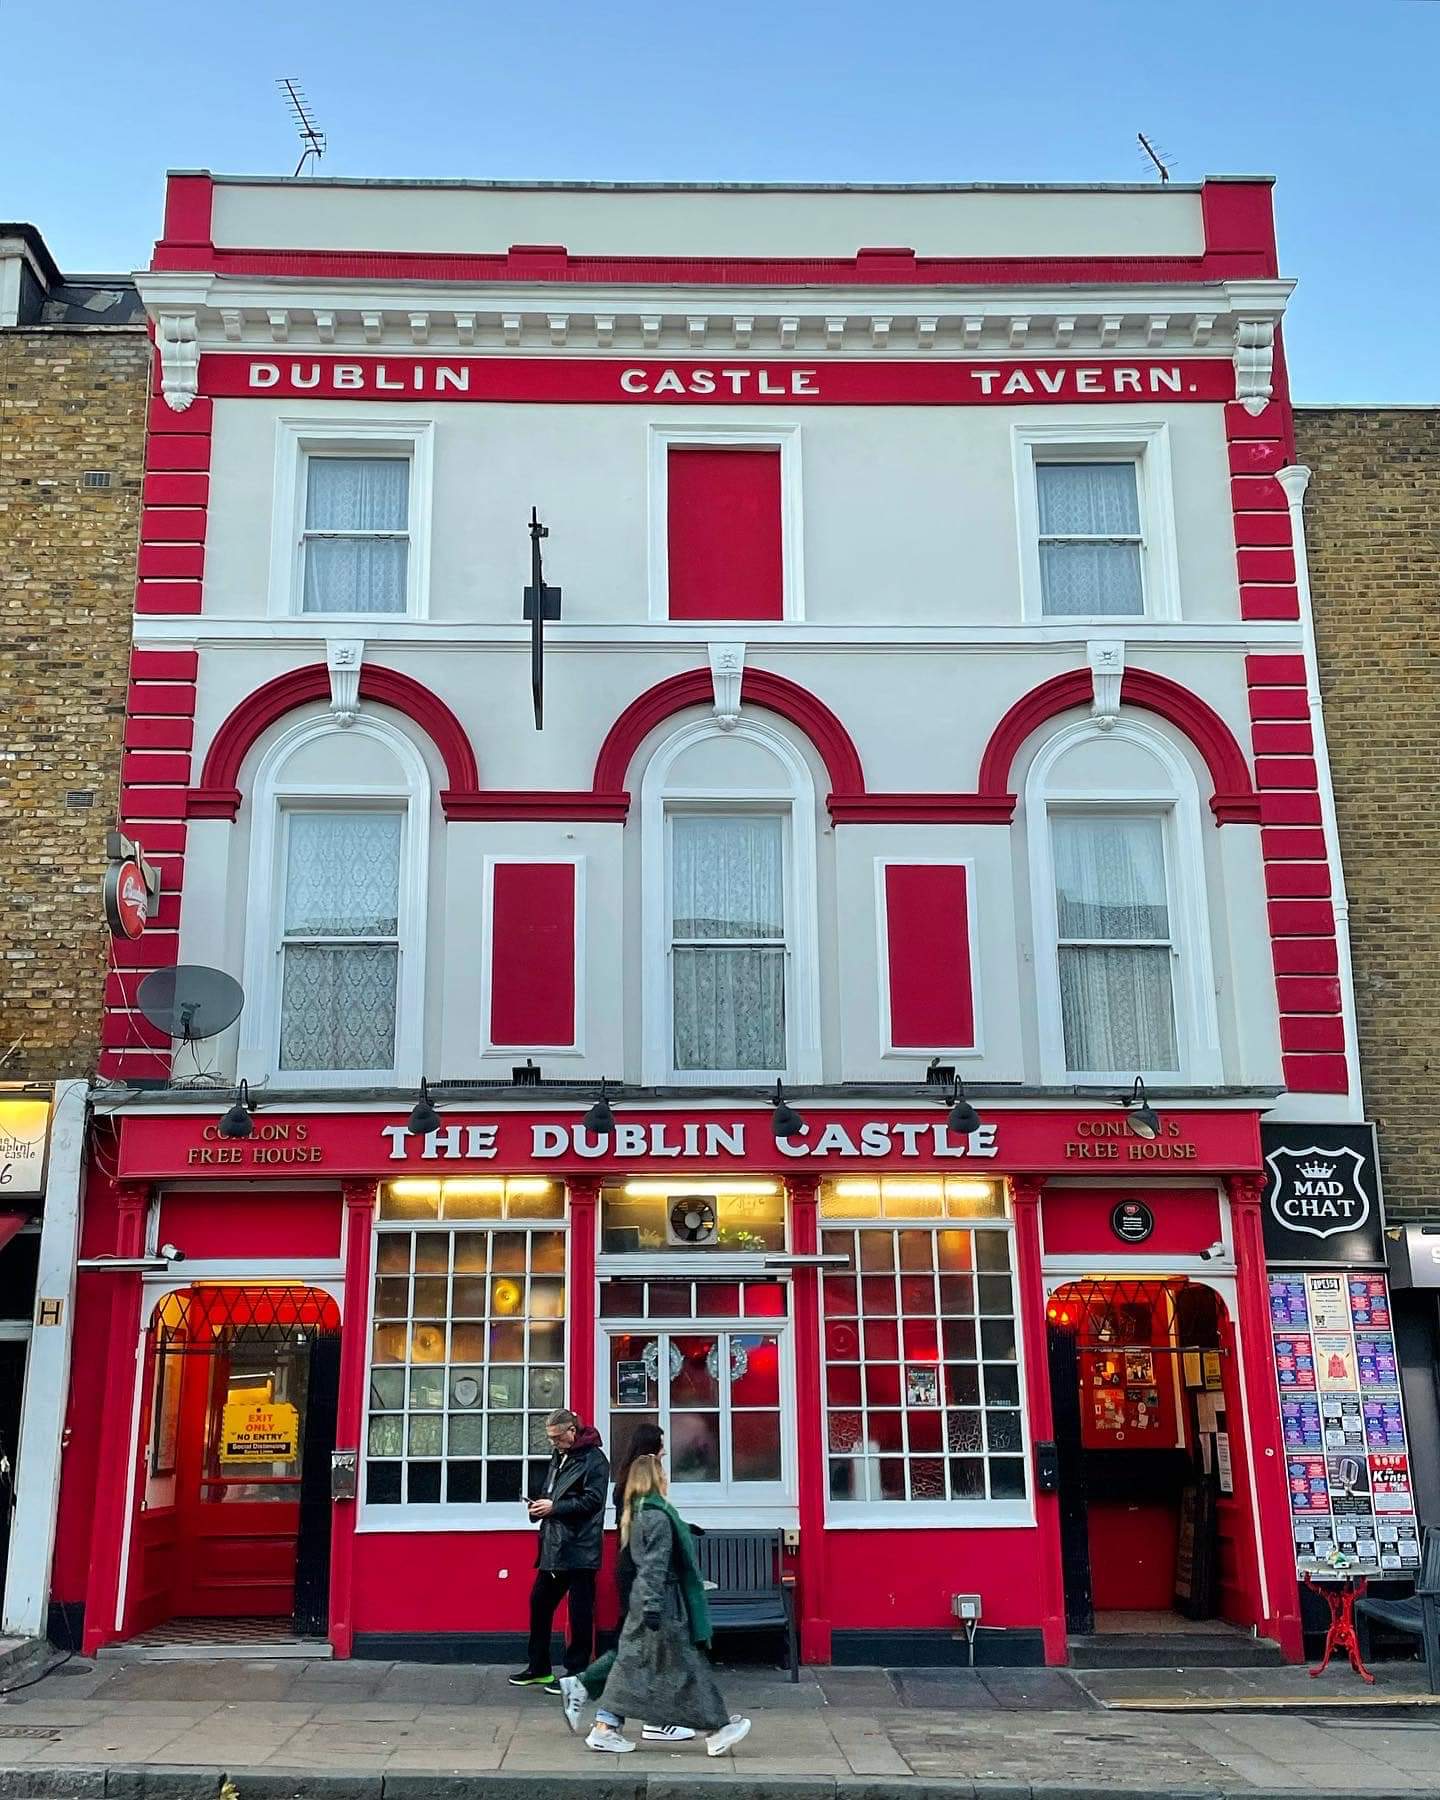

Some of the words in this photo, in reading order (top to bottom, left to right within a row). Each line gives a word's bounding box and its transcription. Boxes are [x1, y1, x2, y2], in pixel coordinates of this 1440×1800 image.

[248, 363, 470, 391] DUBLIN
[620, 367, 821, 396] CASTLE
[970, 367, 1197, 394] TAVERN.
[203, 1124, 289, 1140] CLON
[381, 1125, 499, 1159] THE
[530, 1123, 746, 1158] DUBLIN
[775, 1122, 999, 1158] CASTLE
[4, 1141, 36, 1159] castle
[187, 1147, 243, 1164] FREE
[253, 1146, 323, 1163] HOUSE
[1065, 1142, 1119, 1158] FREE
[1129, 1143, 1198, 1160] HOUSE
[1293, 1181, 1345, 1196] MAD
[1284, 1199, 1356, 1217] CHAT
[39, 1301, 61, 1325] H
[248, 1414, 273, 1422] EXIT
